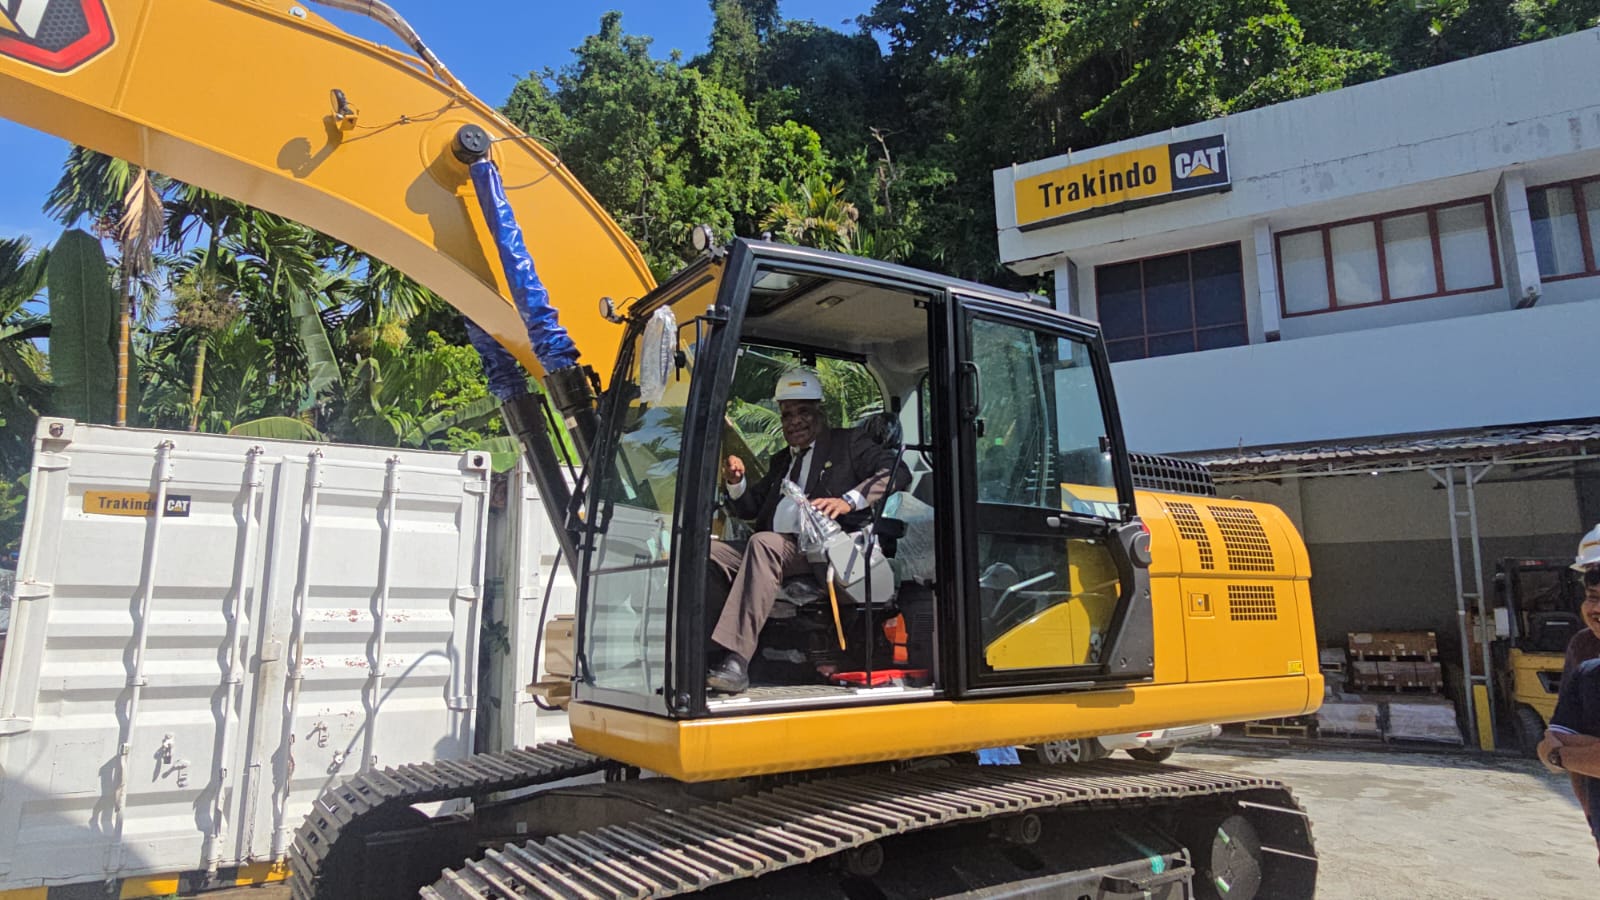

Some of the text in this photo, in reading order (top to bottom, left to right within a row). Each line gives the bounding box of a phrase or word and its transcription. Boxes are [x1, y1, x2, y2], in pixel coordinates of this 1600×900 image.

[1038, 146, 1222, 207] Trakindo CAT
[167, 499, 189, 512] CAT
